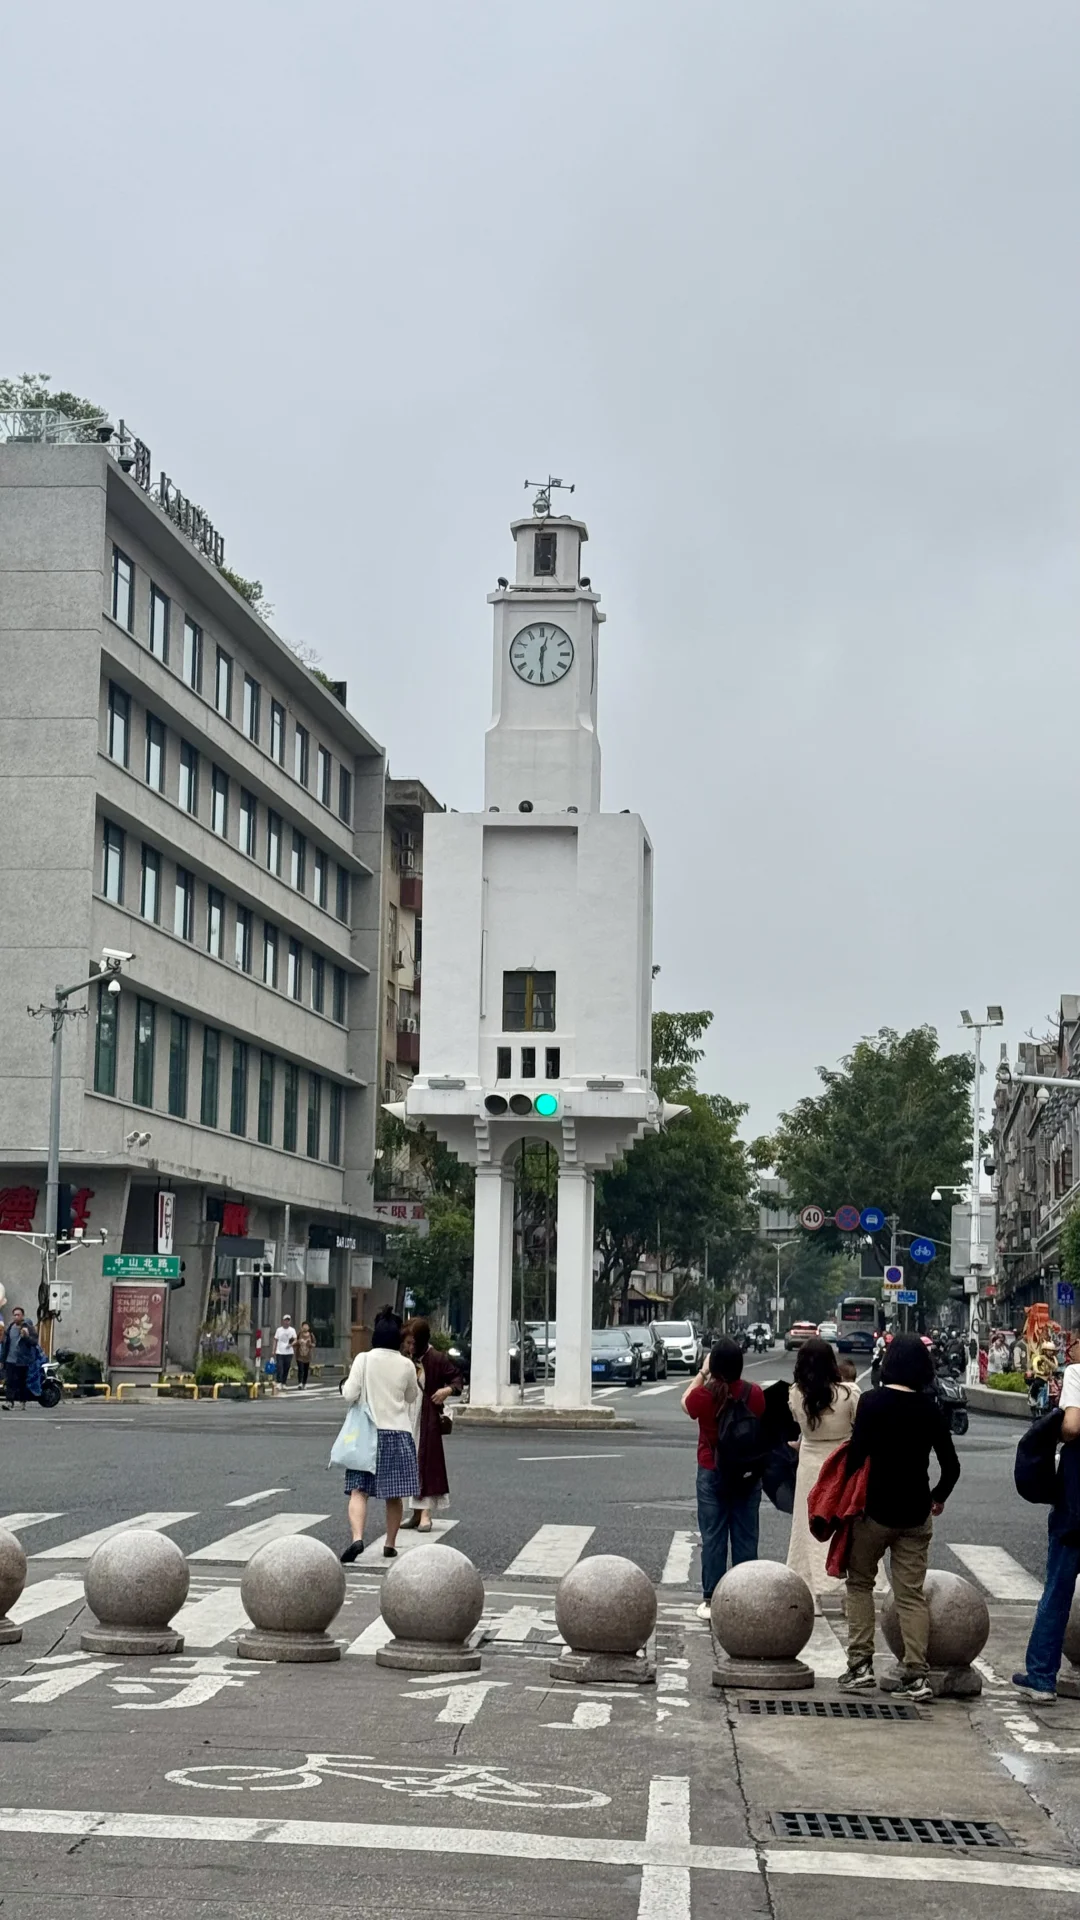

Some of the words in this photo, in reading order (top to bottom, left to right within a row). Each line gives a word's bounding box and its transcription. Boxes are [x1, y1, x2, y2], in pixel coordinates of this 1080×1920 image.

[805, 1211, 820, 1224] 40
[114, 1256, 168, 1269] 中山北路
